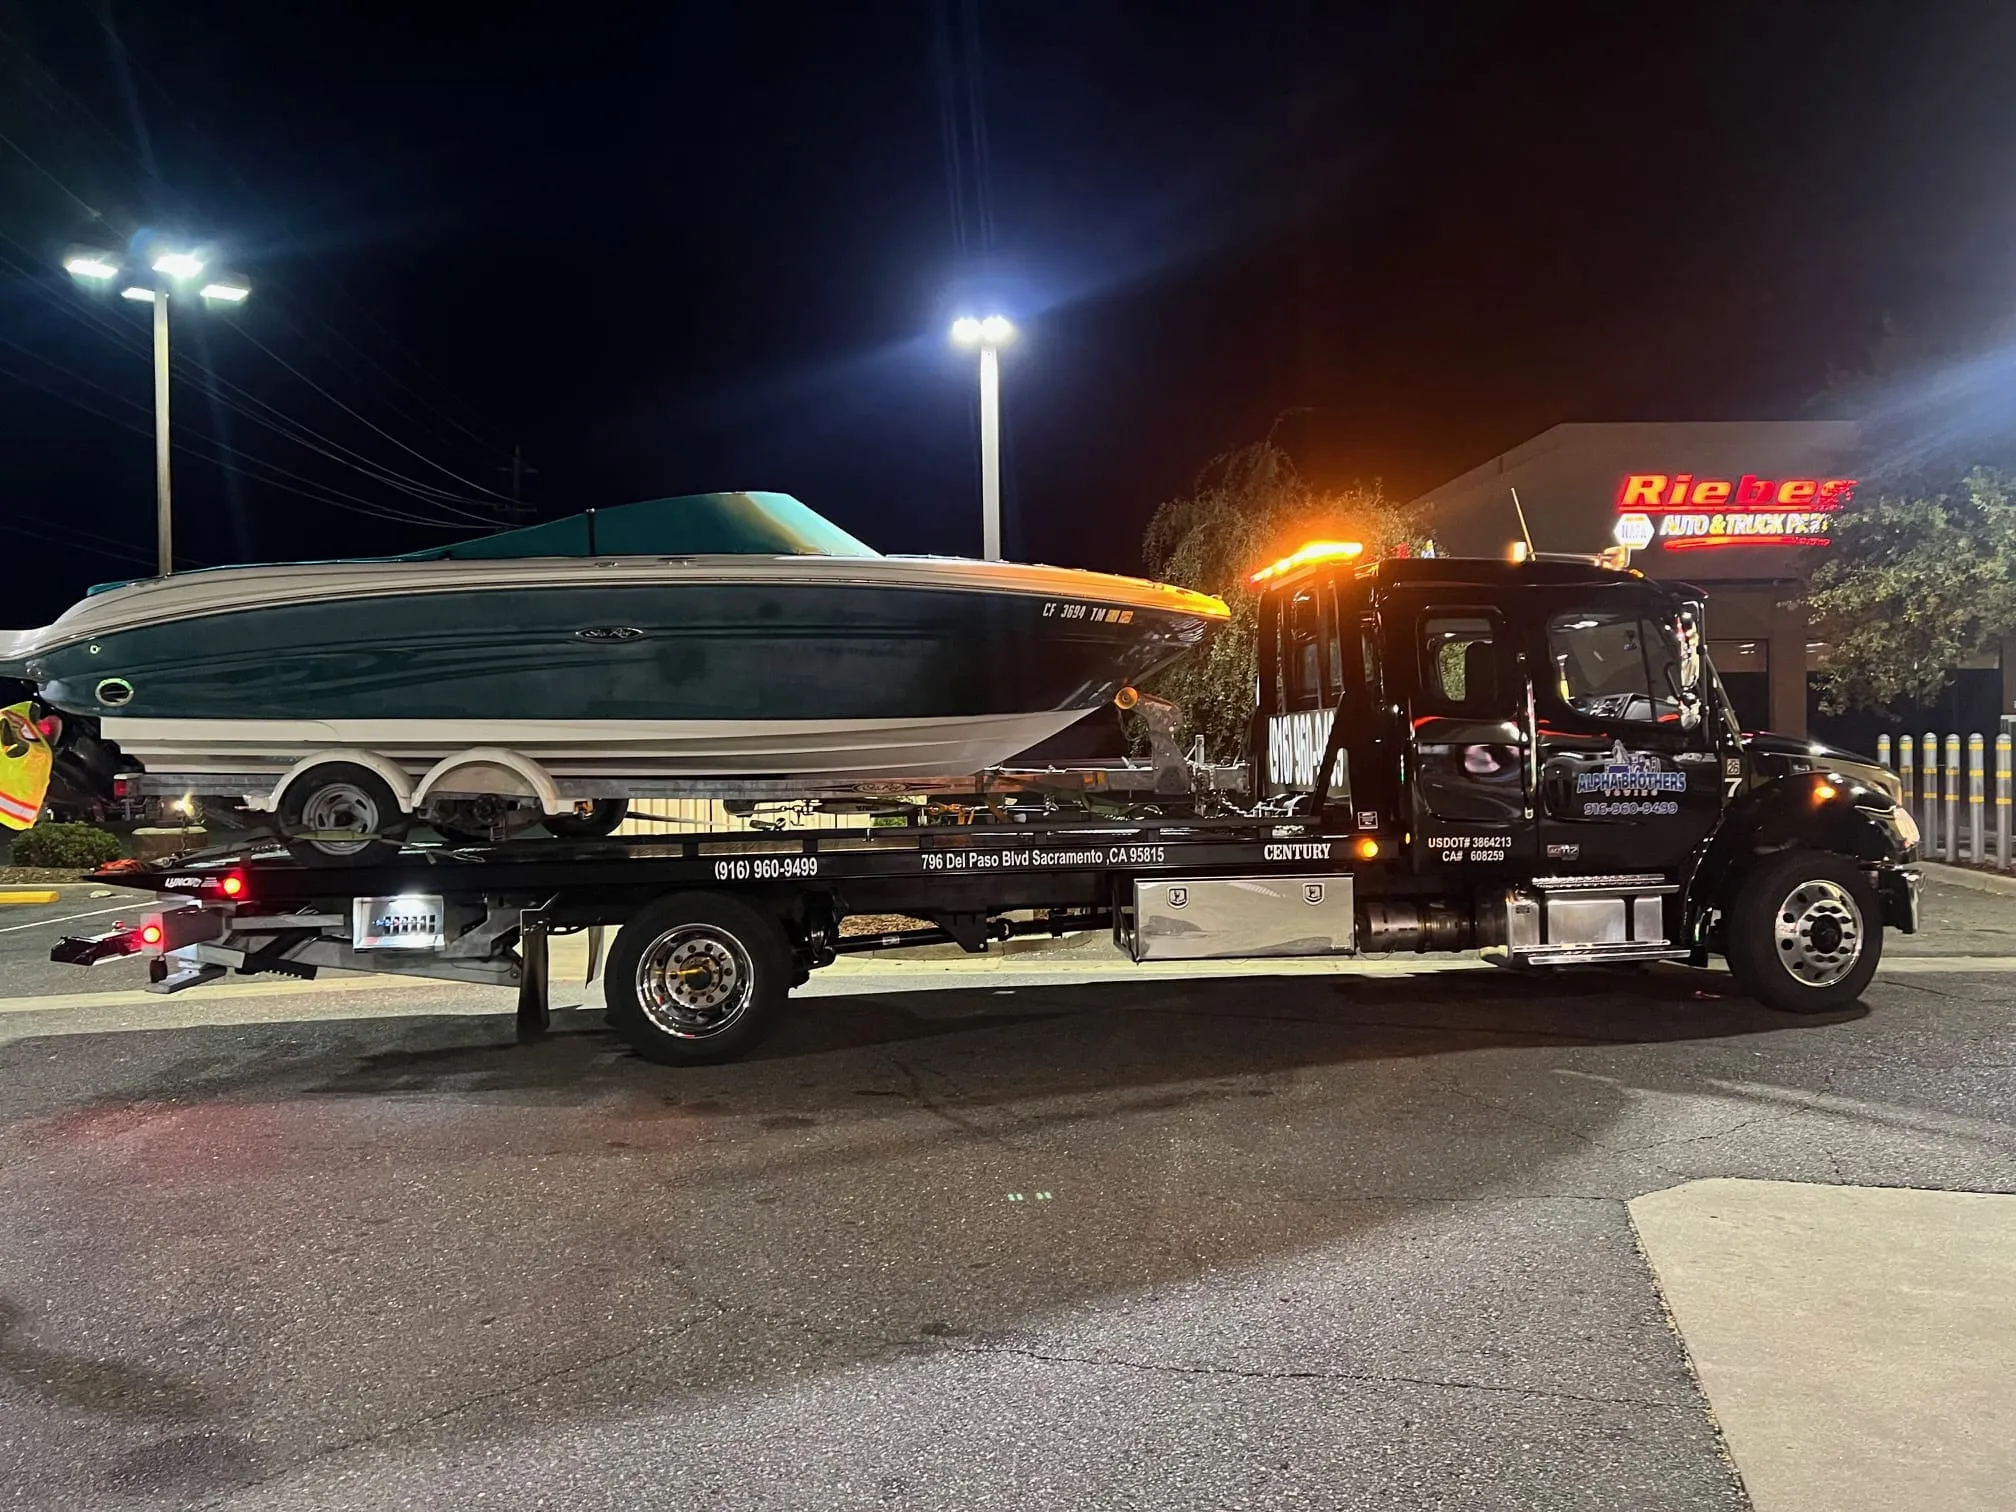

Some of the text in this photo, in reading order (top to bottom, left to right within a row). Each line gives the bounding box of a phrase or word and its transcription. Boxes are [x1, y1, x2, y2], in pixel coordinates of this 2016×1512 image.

[1660, 514, 1709, 535] AUTO
[1709, 514, 1727, 535] &
[1725, 513, 1784, 534] TRUCK
[1042, 602, 1056, 617] CF
[1090, 607, 1107, 622] TM
[1577, 772, 1686, 793] ALPHA BROTHERS
[1725, 778, 1742, 797] 7
[1584, 802, 1678, 815] 916-960-9499
[1264, 843, 1331, 860] CENTURY
[1428, 837, 1512, 848] USDOT# 3864213
[921, 854, 943, 870] 796
[946, 852, 966, 869] Del
[969, 852, 999, 868] Paso
[1002, 850, 1029, 866] Blvd
[1032, 848, 1103, 866] Sacramento
[1129, 846, 1165, 863] 95815
[1442, 850, 1504, 861] CA# 608259
[714, 857, 818, 880] (916) 960-9499
